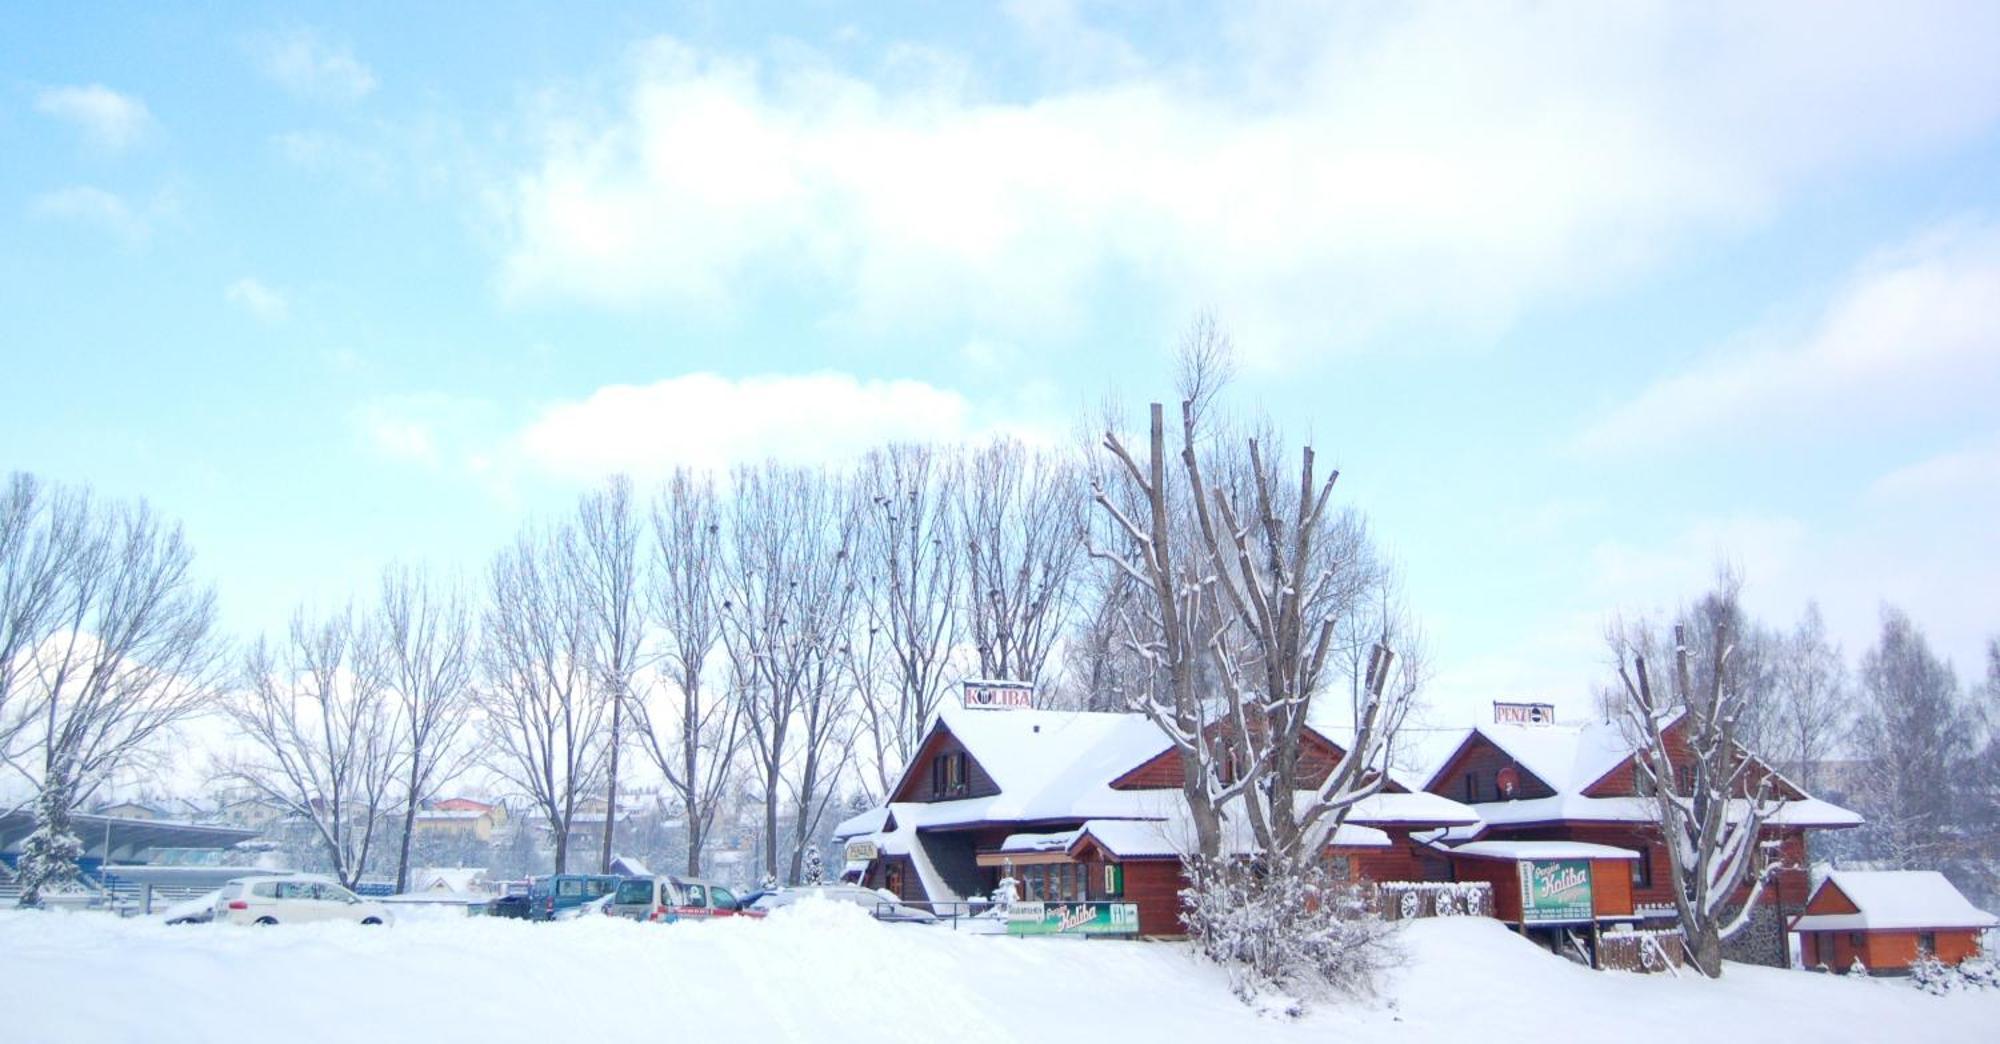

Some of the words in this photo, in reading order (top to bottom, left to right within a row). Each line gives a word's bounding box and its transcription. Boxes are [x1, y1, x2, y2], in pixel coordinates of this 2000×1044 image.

[966, 688, 1030, 705] KOLIBA
[1540, 867, 1587, 897] Koliba
[1057, 903, 1097, 932] Koliba
